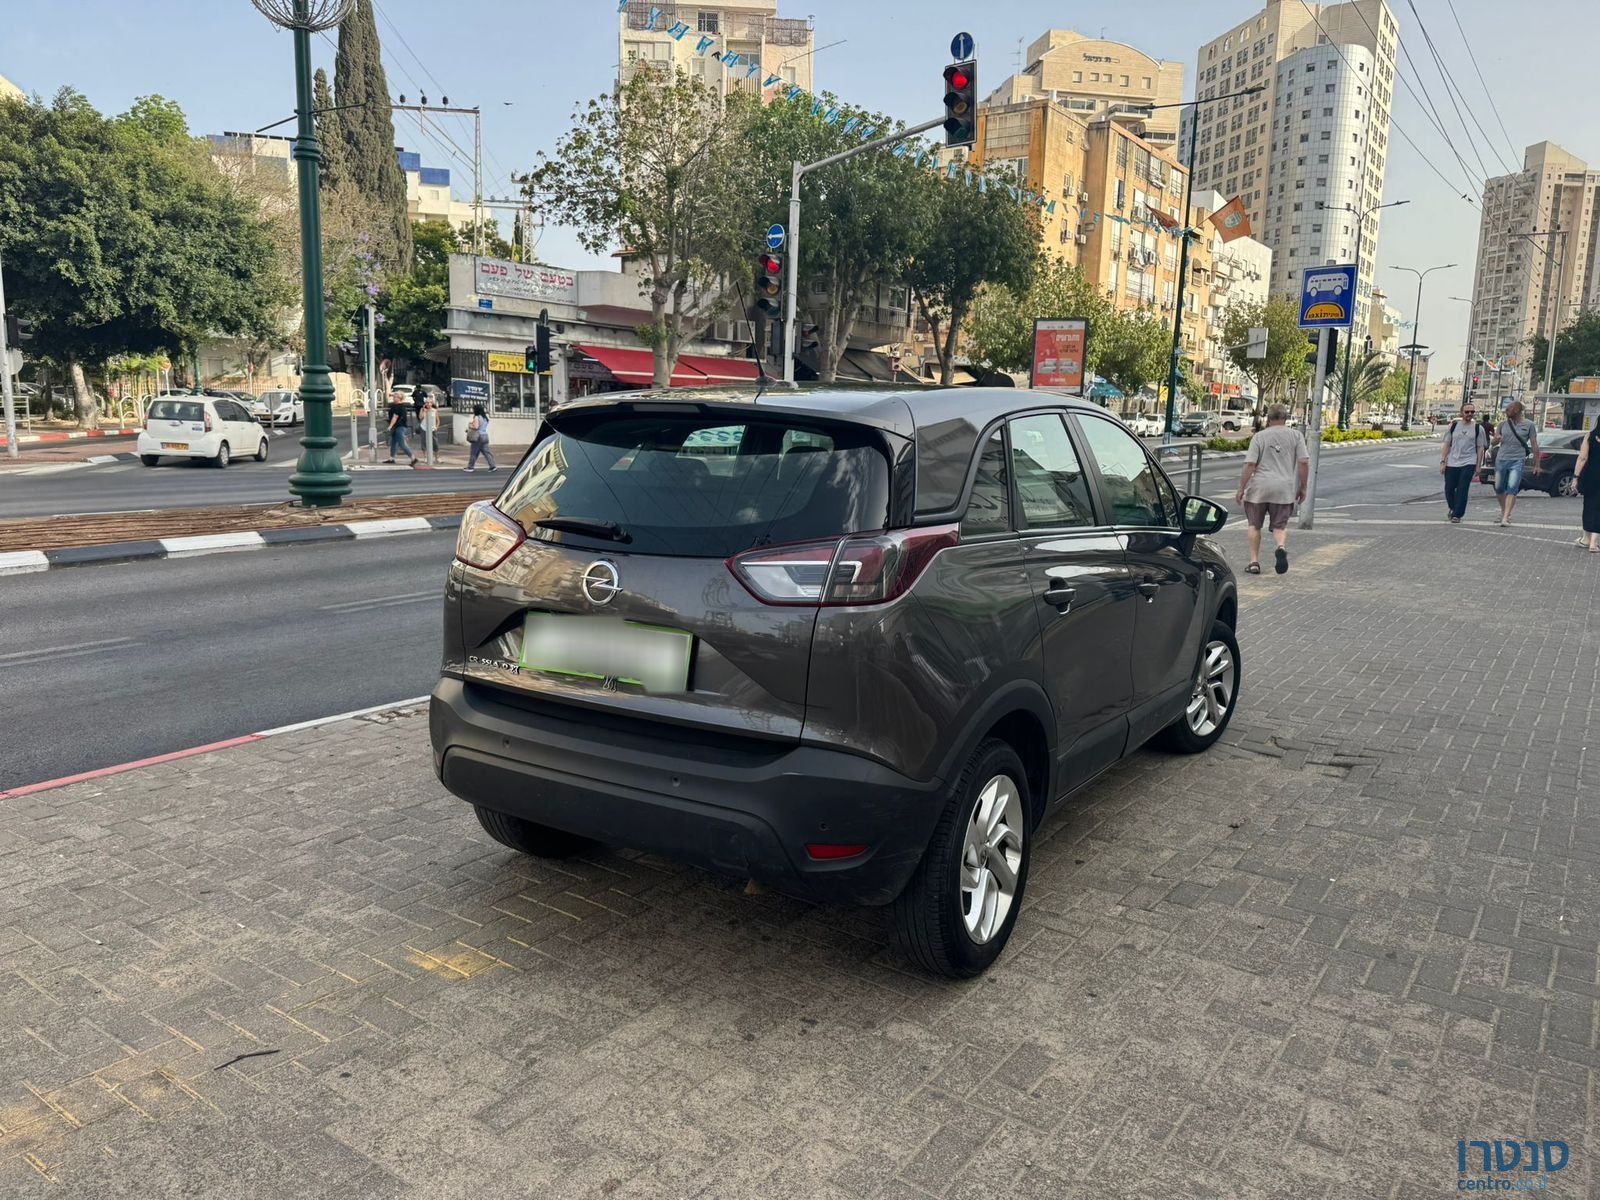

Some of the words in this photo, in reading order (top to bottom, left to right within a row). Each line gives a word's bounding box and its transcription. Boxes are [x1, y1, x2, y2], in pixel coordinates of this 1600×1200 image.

[480, 262, 508, 276] פעם
[514, 264, 534, 280] של
[540, 271, 575, 287] בטעם
[468, 655, 509, 670] CRSSLAD
